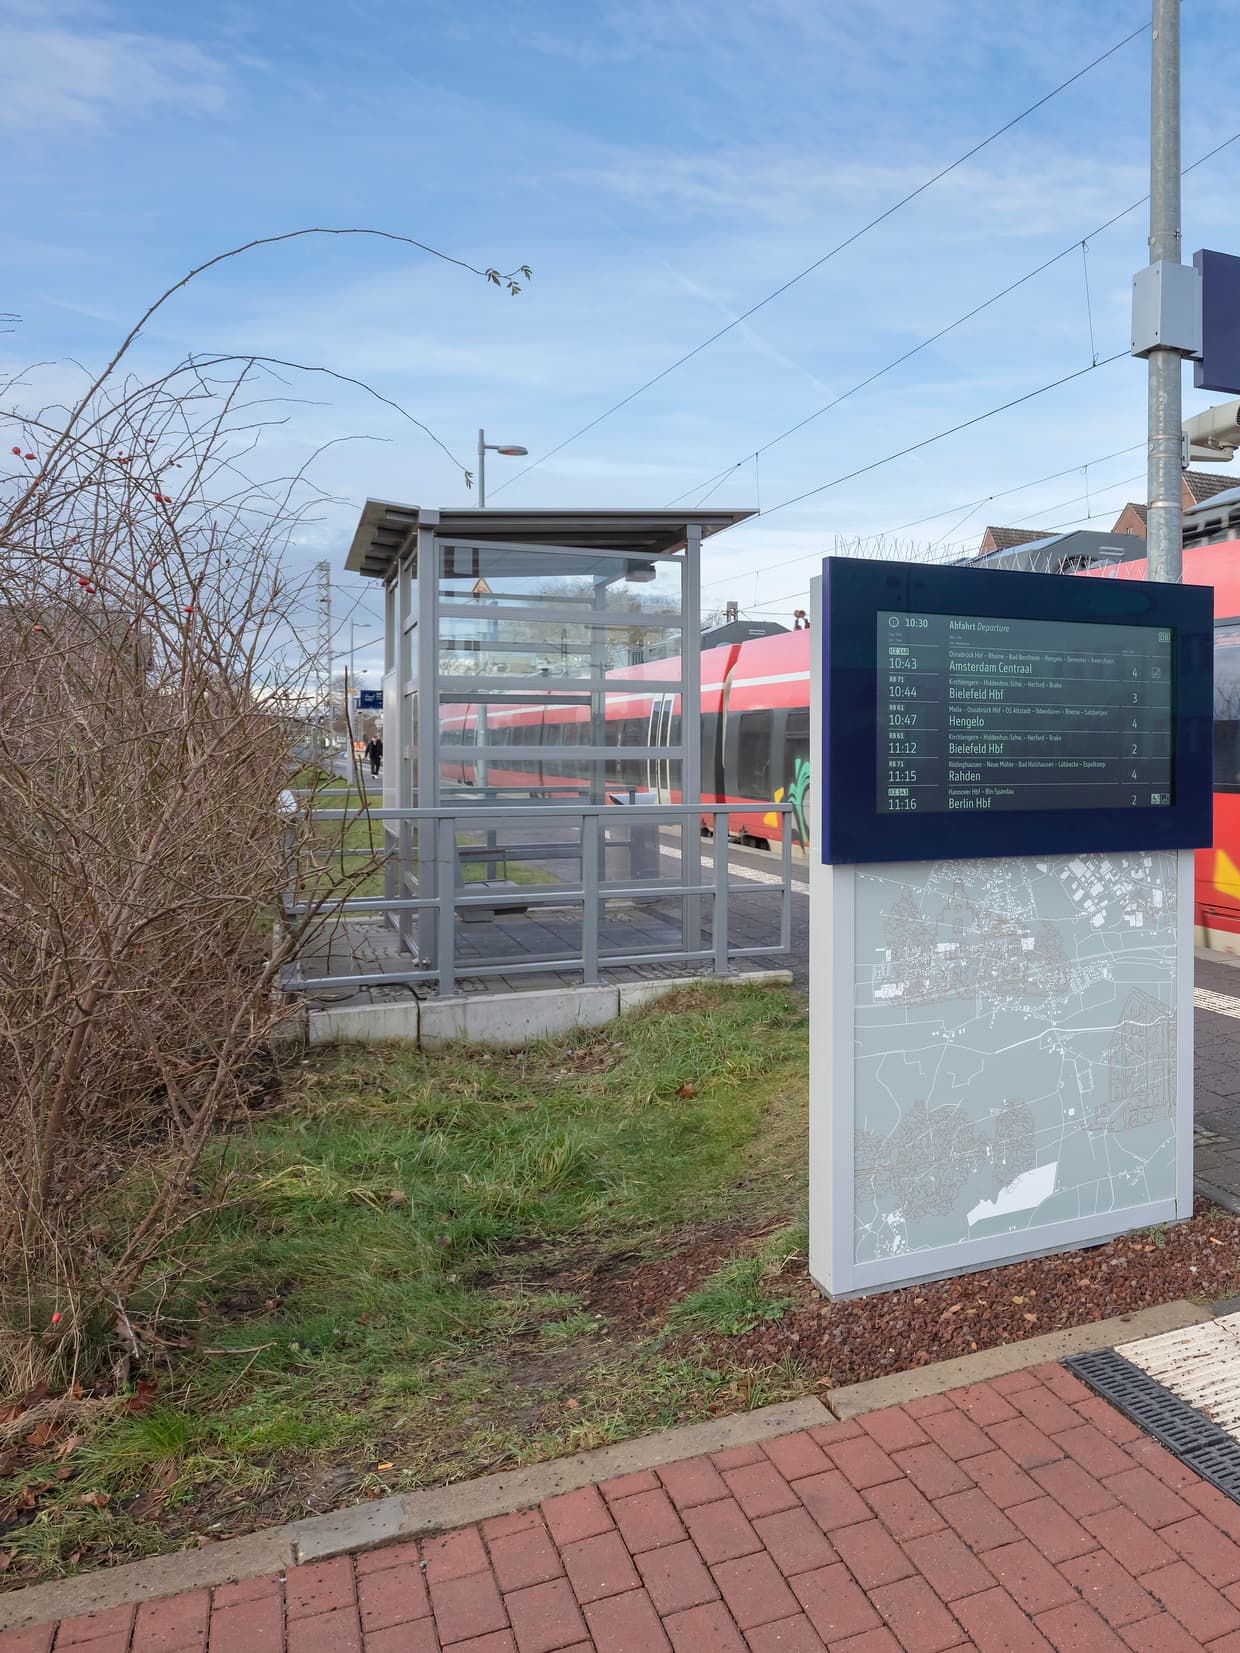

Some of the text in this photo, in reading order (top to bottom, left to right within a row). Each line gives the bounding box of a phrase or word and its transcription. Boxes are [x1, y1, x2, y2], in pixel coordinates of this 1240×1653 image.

[905, 618, 928, 628] 10:30
[949, 620, 1010, 633] Abfahrt Departure
[889, 658, 918, 669] 10:43
[949, 660, 1033, 674] Amsterdam Centraal
[1131, 667, 1138, 678] 4
[897, 675, 905, 683] 71
[889, 685, 918, 697] 10:44
[949, 687, 1005, 700] Bielefeld Hbf
[1131, 692, 1138, 704] 3
[889, 714, 918, 726] 10:47
[949, 715, 985, 728] Hengelo
[1131, 718, 1138, 729] 4
[889, 742, 918, 754] 11:12
[949, 742, 1004, 754] Bielefeld Hbf
[1131, 743, 1138, 755] 2
[897, 760, 905, 768] 71
[889, 770, 918, 782] 11:15
[949, 770, 981, 782] Rahden
[1131, 769, 1137, 780] 4
[889, 798, 918, 810] 11:16
[948, 797, 991, 809] Berlin Hbf
[1131, 794, 1137, 806] 2
